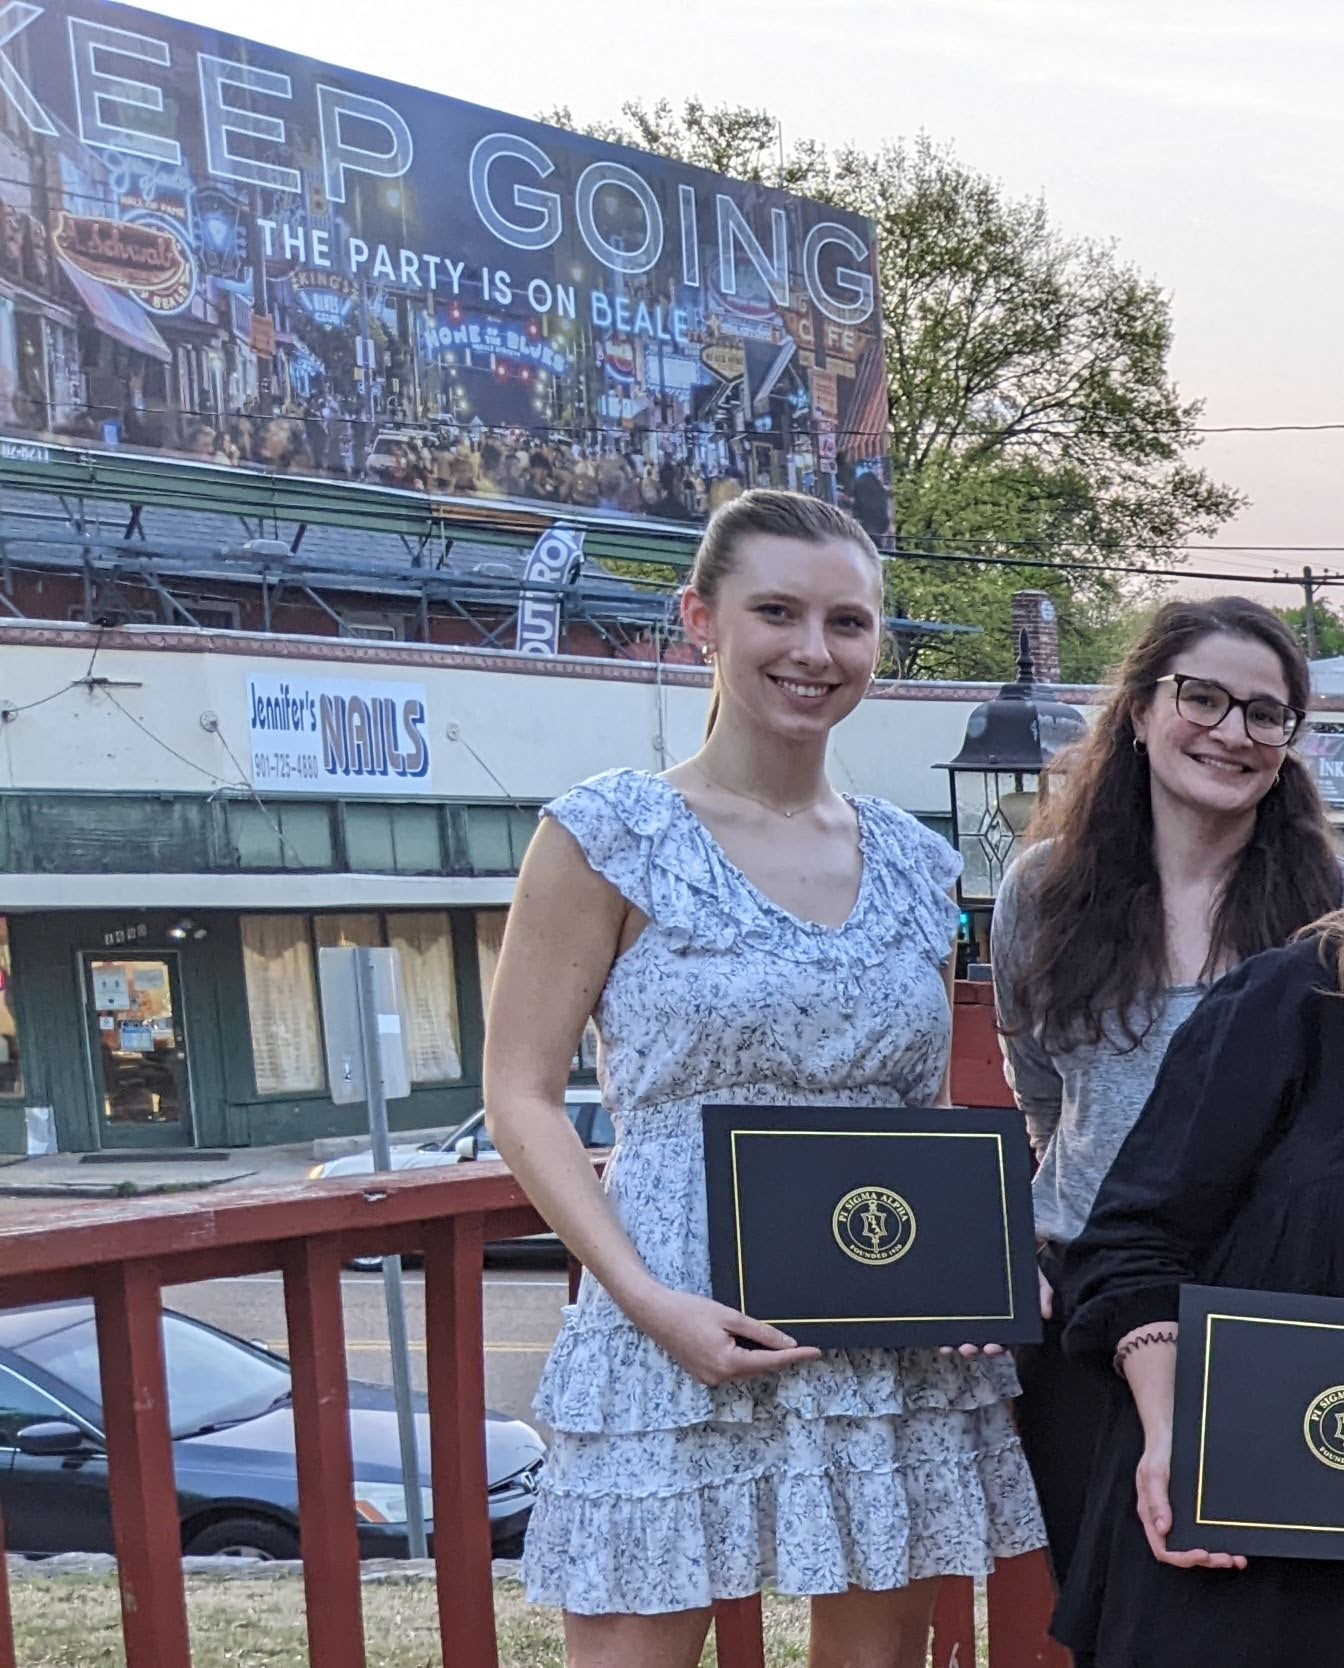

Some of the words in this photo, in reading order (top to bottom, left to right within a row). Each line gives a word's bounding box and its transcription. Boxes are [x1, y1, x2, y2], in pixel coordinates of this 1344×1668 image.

[469, 132, 875, 325] GOING
[257, 218, 331, 267] THE
[349, 237, 465, 294] PARTY
[482, 265, 513, 305] IS
[528, 278, 576, 319] ON
[591, 291, 689, 342] BEALE
[423, 324, 482, 349] HOME
[251, 682, 317, 732] Jennifer's
[319, 693, 430, 778] NAILS
[839, 1211, 848, 1222] PI
[845, 1192, 877, 1210] SIGMA
[881, 1194, 909, 1222] ALPHA
[850, 1244, 887, 1259] FOUNDED
[889, 1244, 902, 1256] 1920
[1311, 1410, 1322, 1421] PI
